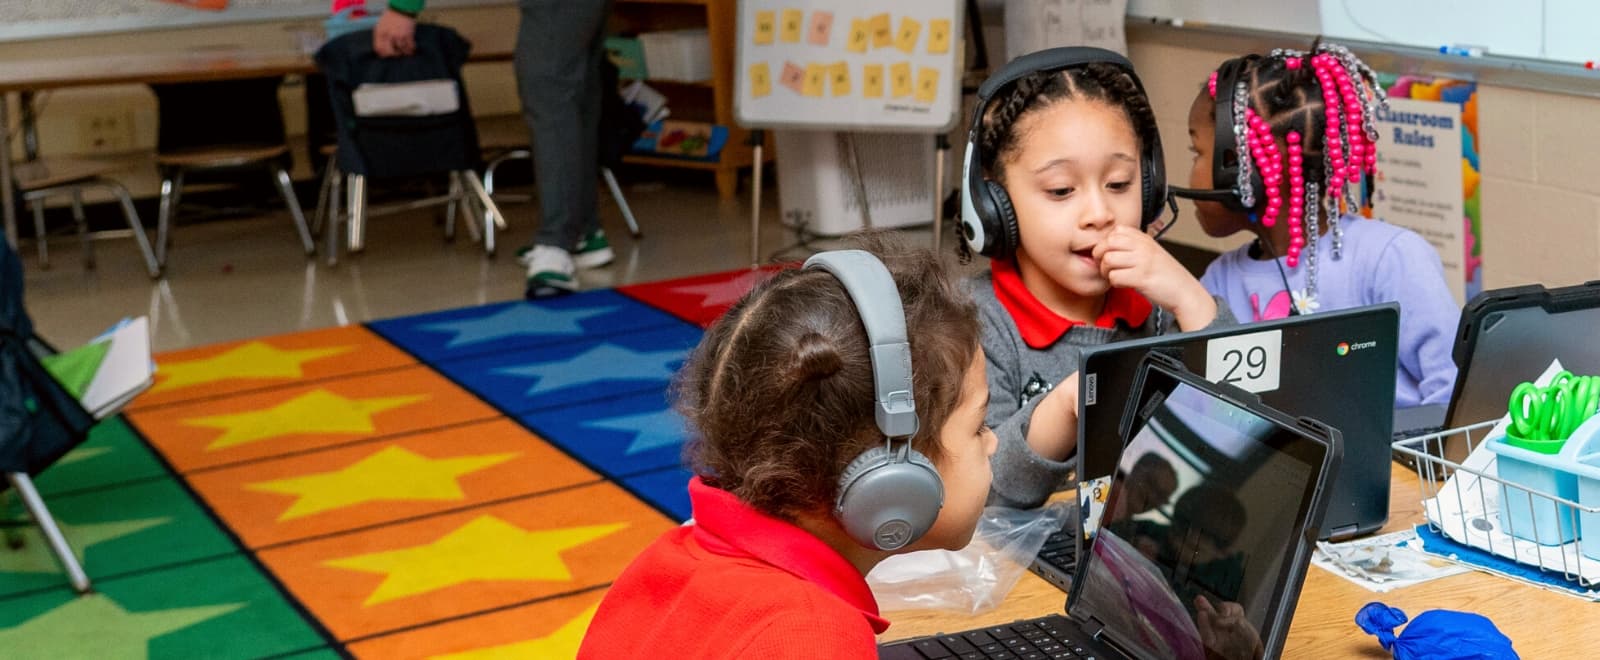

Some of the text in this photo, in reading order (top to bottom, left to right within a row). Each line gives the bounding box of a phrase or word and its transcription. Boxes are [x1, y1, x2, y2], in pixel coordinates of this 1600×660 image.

[1393, 127, 1435, 149] Rules
[1351, 340, 1377, 351] chrome
[1223, 346, 1267, 383] 29
